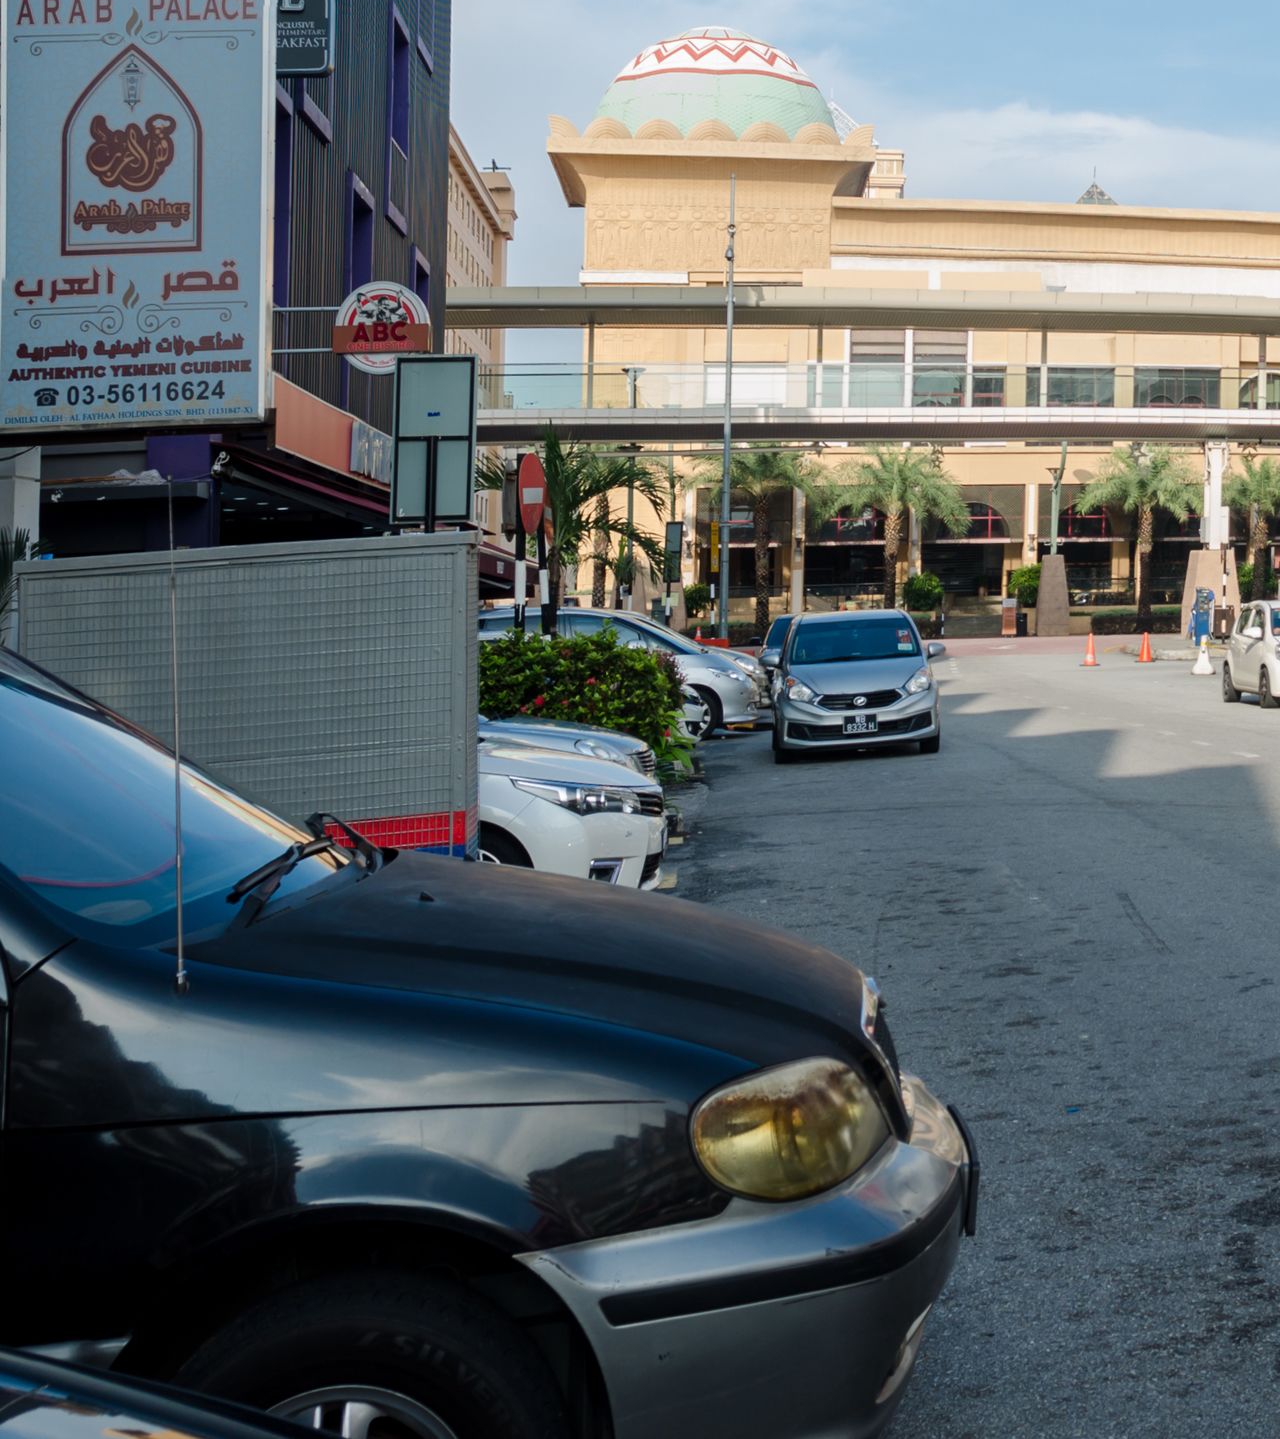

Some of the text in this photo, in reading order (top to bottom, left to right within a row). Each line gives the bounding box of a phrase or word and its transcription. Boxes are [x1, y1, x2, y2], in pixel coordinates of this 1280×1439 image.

[276, 21, 315, 29] NCLUSIVE
[276, 37, 328, 48] EAKFAST
[14, 260, 240, 305] قصر العرب
[353, 322, 408, 343] ABC
[347, 341, 370, 351] ONE
[8, 359, 253, 382] AUTHENTIC YEMENI CUISINE
[67, 380, 226, 406] 03-56116624
[5, 415, 38, 424] DIMILKI
[82, 412, 115, 421] FAYHAA
[118, 410, 163, 419] HOLDINGS
[847, 723, 867, 732] 8332
